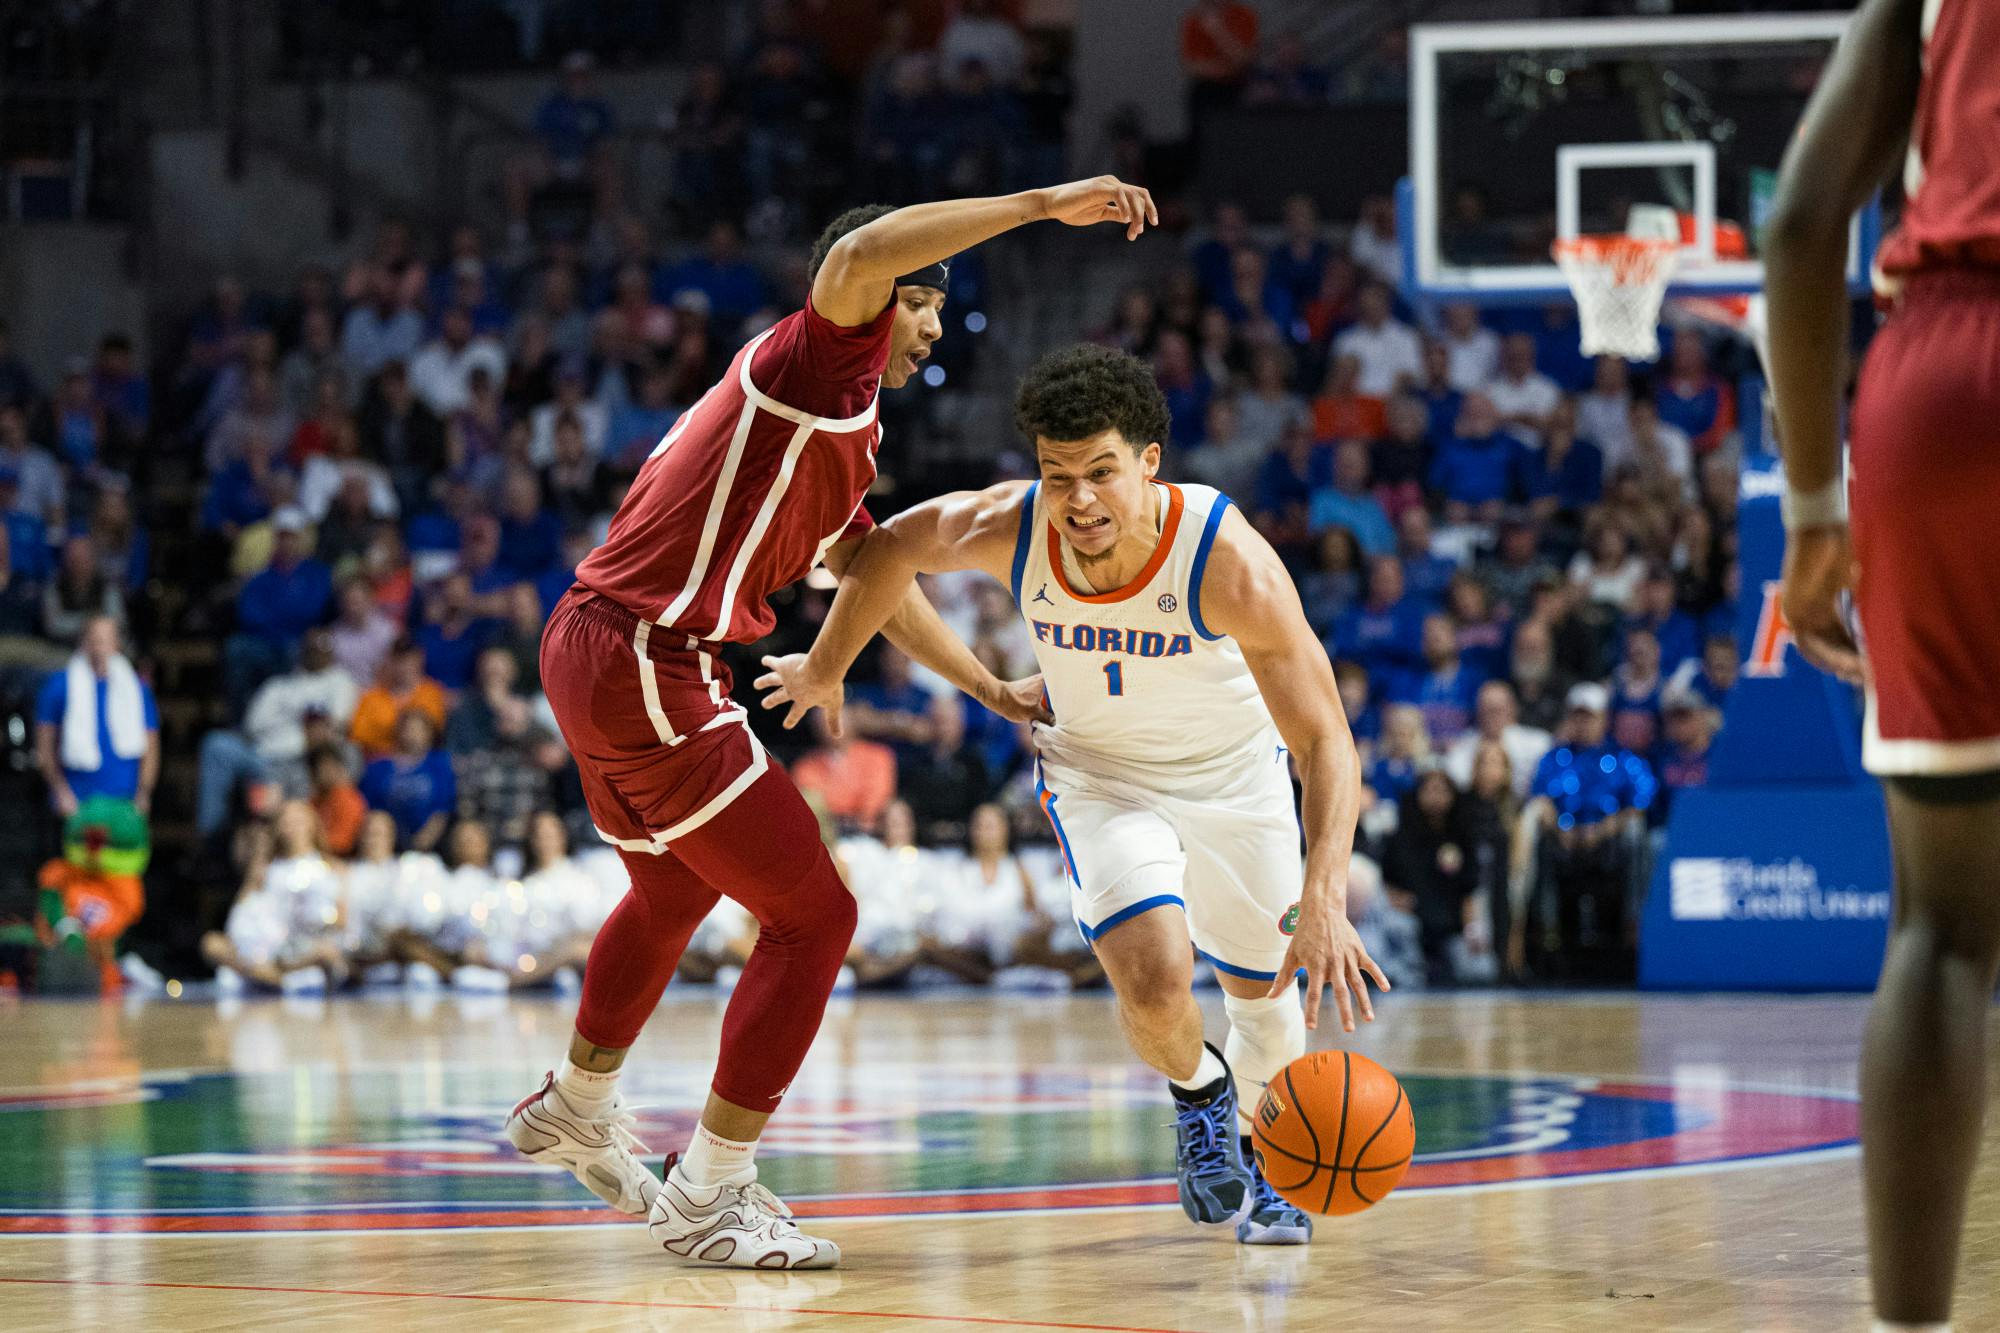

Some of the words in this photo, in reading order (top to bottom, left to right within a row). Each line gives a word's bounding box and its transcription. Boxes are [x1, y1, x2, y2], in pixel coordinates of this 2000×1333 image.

[1159, 596, 1177, 610] SEC
[1031, 618, 1193, 657] FLORIDA
[1102, 660, 1124, 696] 1
[700, 1127, 748, 1152] Supreme
